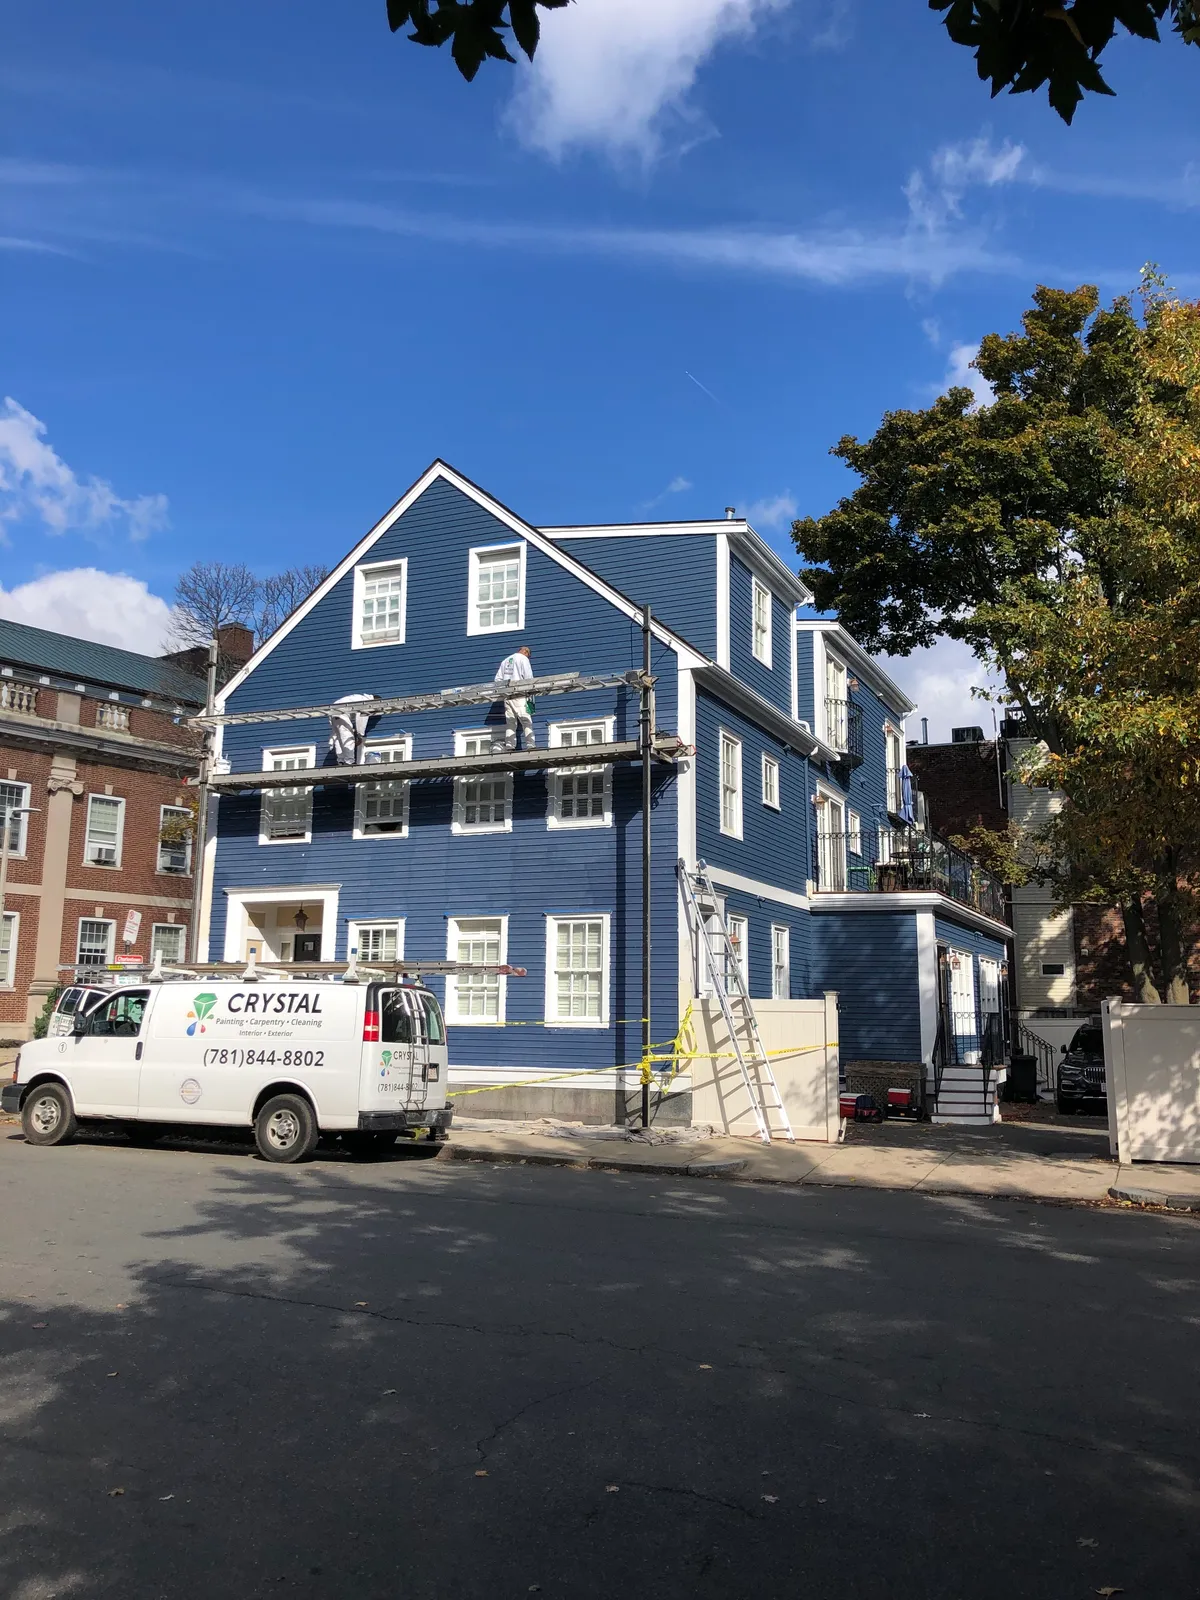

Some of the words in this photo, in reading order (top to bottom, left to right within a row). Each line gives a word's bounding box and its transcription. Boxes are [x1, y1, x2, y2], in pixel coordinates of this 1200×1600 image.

[227, 992, 323, 1014] CRYSTAL
[215, 1017, 245, 1027] Painting
[249, 1018, 285, 1028] Carpentry
[290, 1018, 323, 1028] Cleaning
[203, 1048, 325, 1068] (781)844-8802
[393, 1050, 419, 1061] CRYSTL
